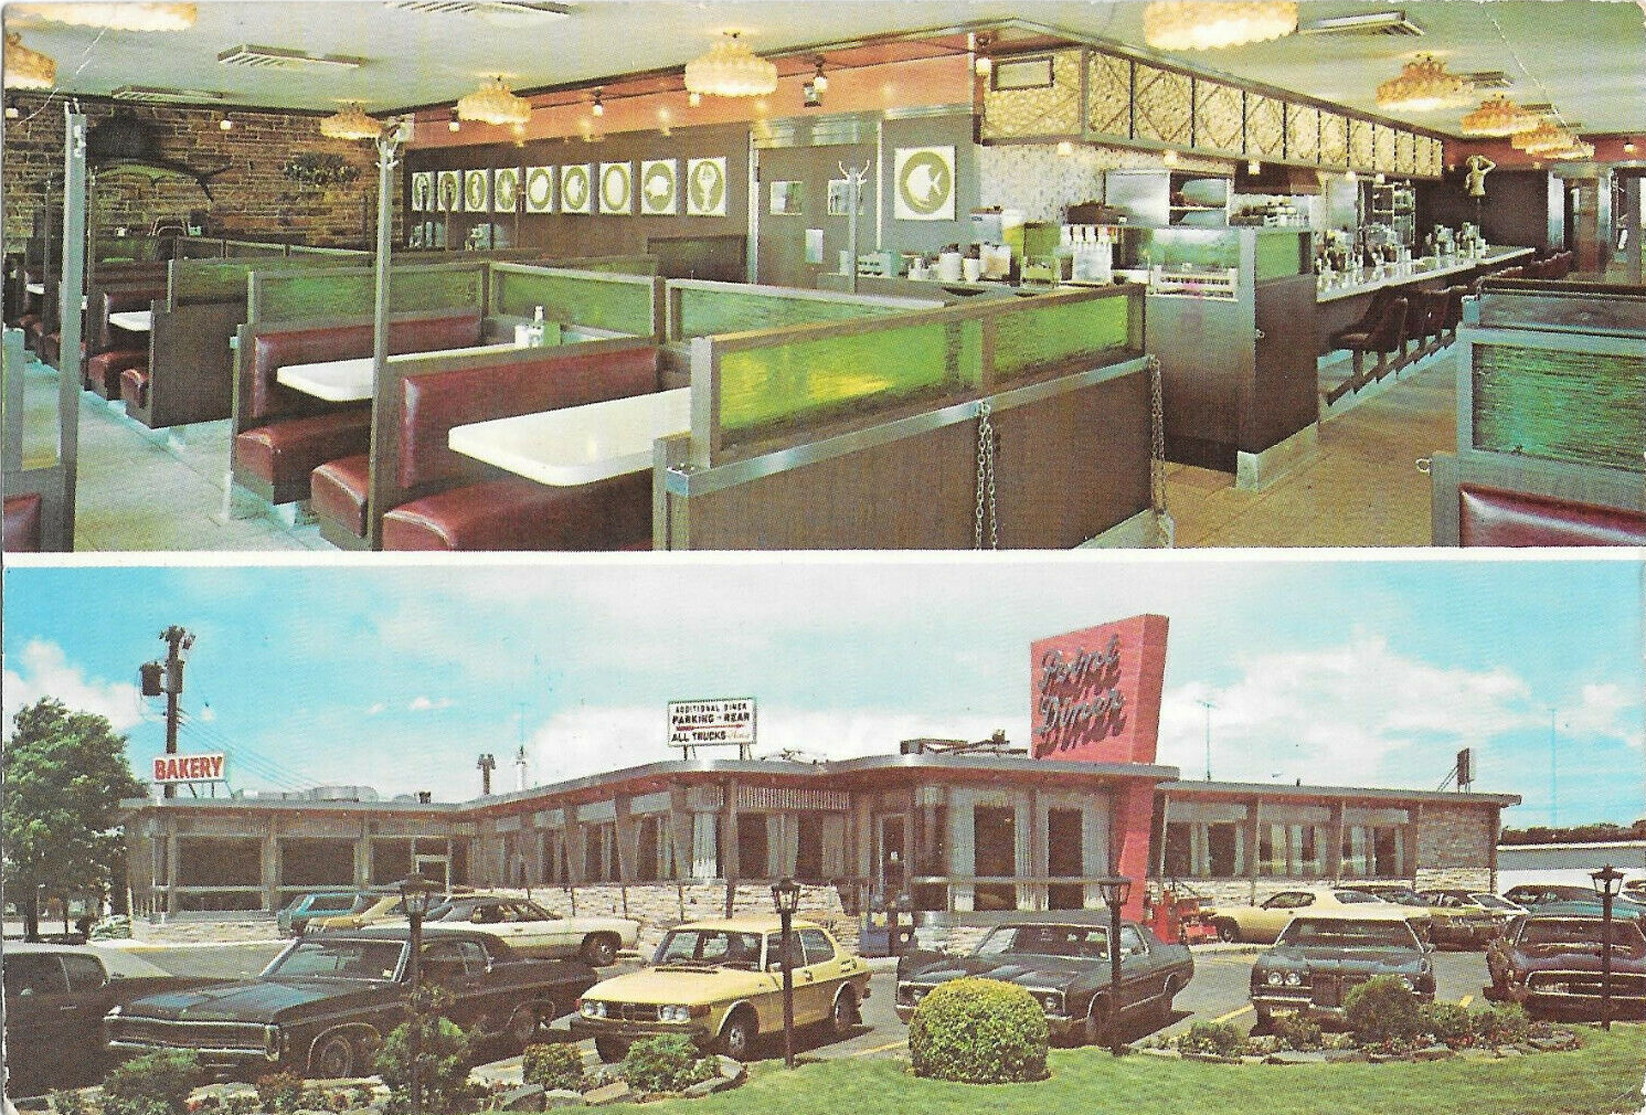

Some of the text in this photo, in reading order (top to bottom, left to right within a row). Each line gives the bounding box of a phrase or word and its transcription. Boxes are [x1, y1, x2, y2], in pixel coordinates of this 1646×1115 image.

[675, 702, 747, 714] ADDITIONAL DINER
[1035, 688, 1125, 734] Diner
[672, 714, 715, 724] PARKING
[724, 712, 750, 722] REAR
[671, 733, 690, 742] ALL
[692, 730, 727, 741] TRUCKS
[155, 756, 223, 780] BAKERY
